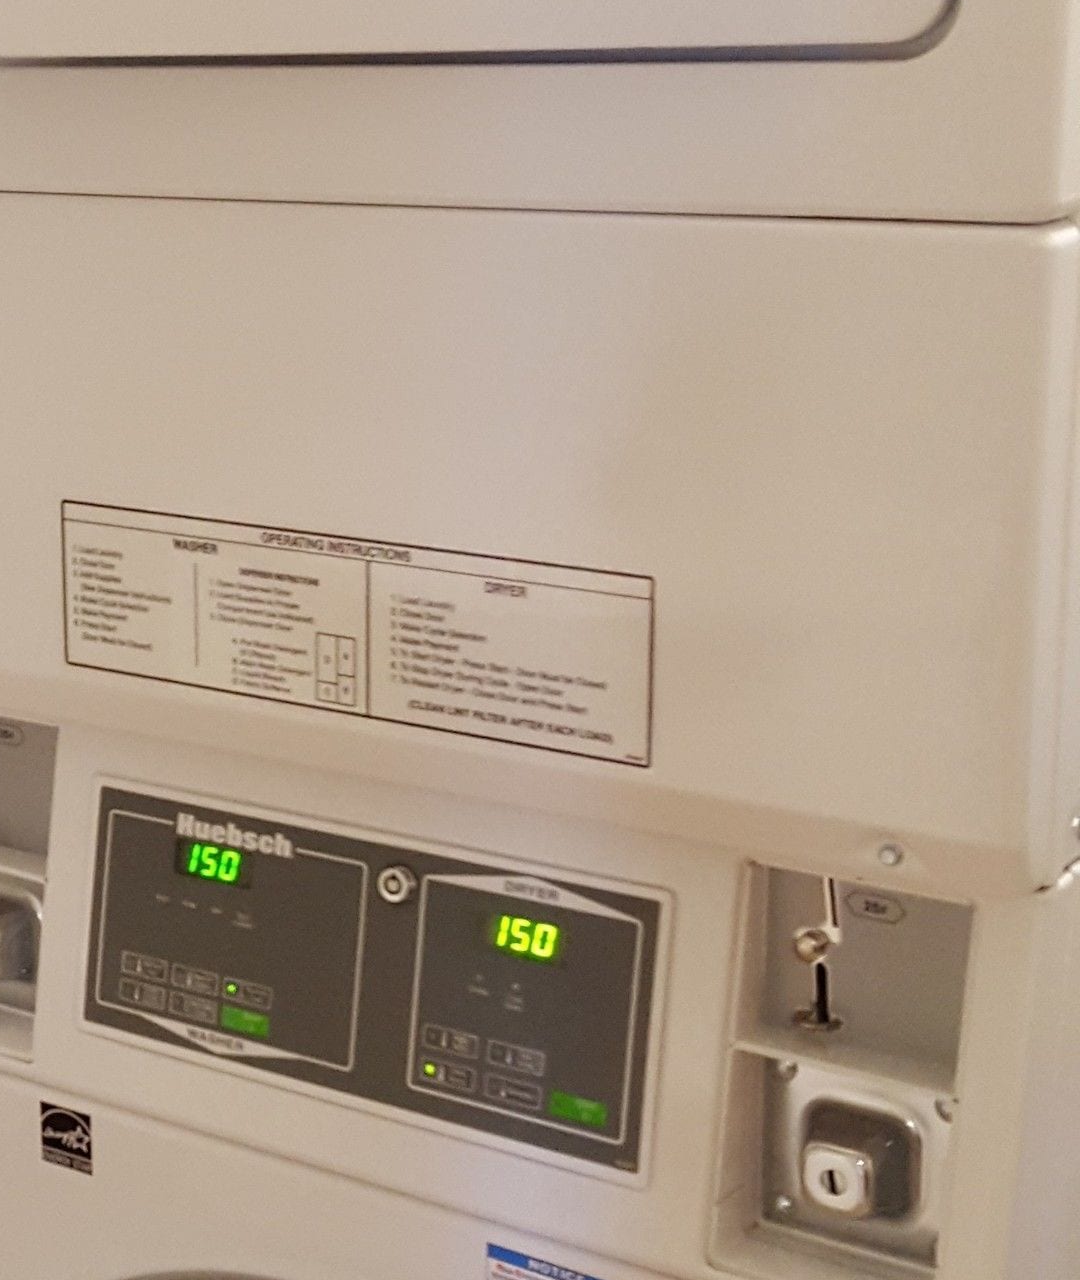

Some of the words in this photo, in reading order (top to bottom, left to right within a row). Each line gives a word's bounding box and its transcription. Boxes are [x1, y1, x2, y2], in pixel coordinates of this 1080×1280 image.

[172, 538, 218, 554] WASHER
[261, 532, 325, 550] OPERATING
[327, 540, 411, 562] INSTRUCTIONS
[484, 581, 528, 597] DRYER
[176, 812, 294, 859] Huebsch
[188, 843, 242, 882] 150
[496, 915, 558, 958] 150
